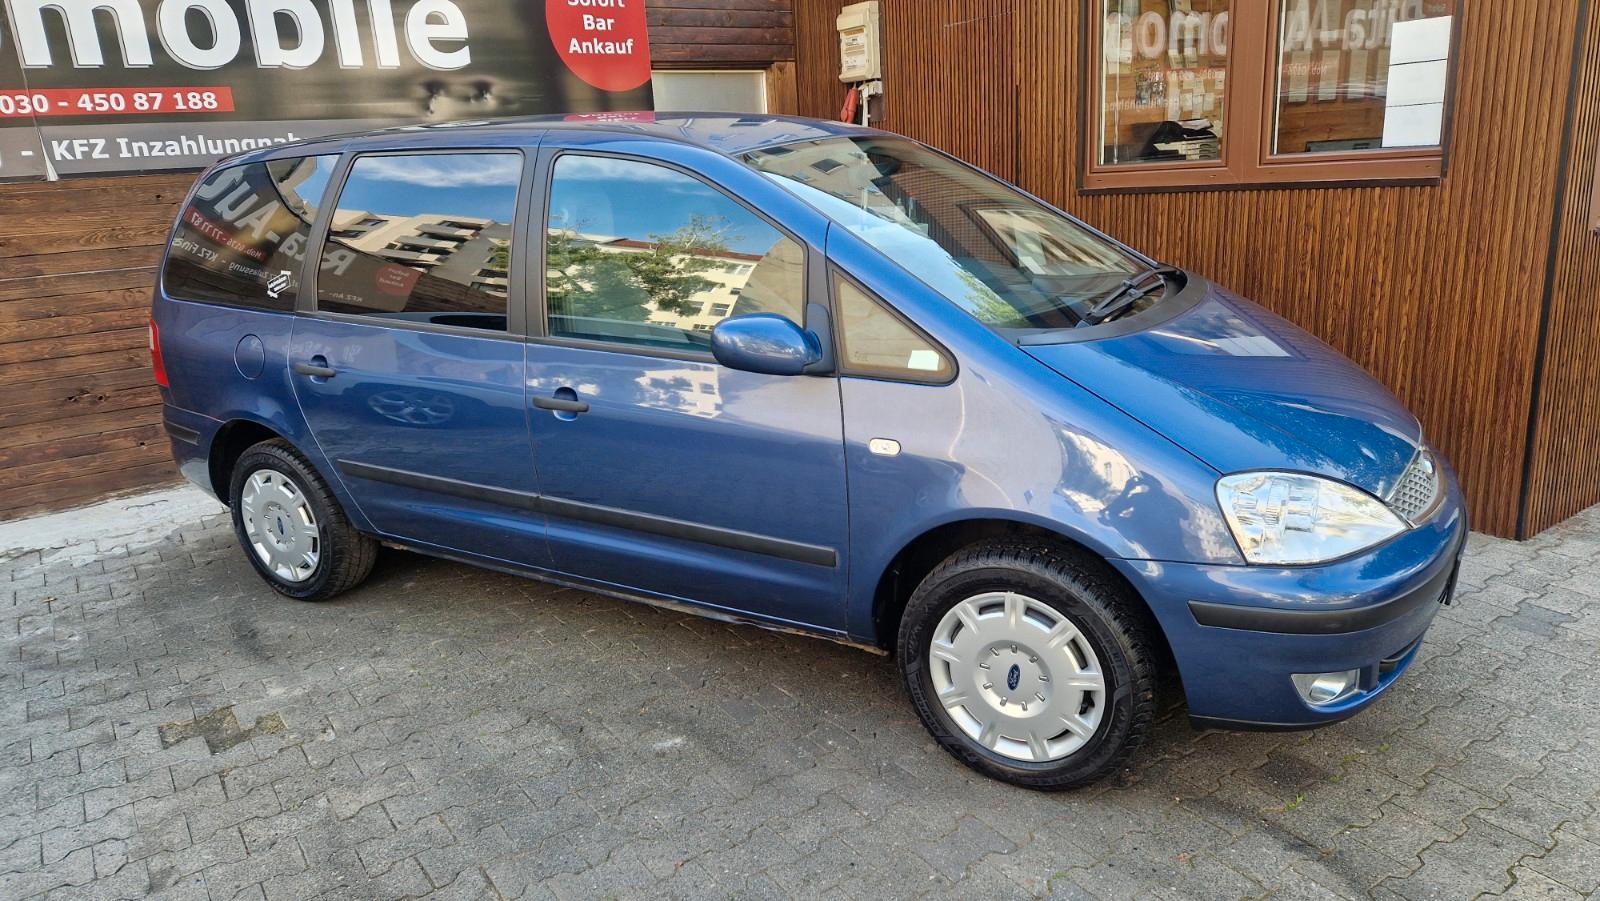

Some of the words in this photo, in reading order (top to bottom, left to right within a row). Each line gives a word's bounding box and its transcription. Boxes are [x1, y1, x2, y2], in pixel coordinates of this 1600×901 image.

[583, 14, 614, 31] Bar
[0, 0, 471, 71] mobile
[569, 37, 633, 54] Ankauf
[0, 94, 49, 114] 030
[77, 92, 125, 112] 450
[133, 92, 163, 110] 87
[174, 91, 218, 109] 188
[51, 138, 110, 161] KFZ
[116, 132, 305, 158] Inzahlungn
